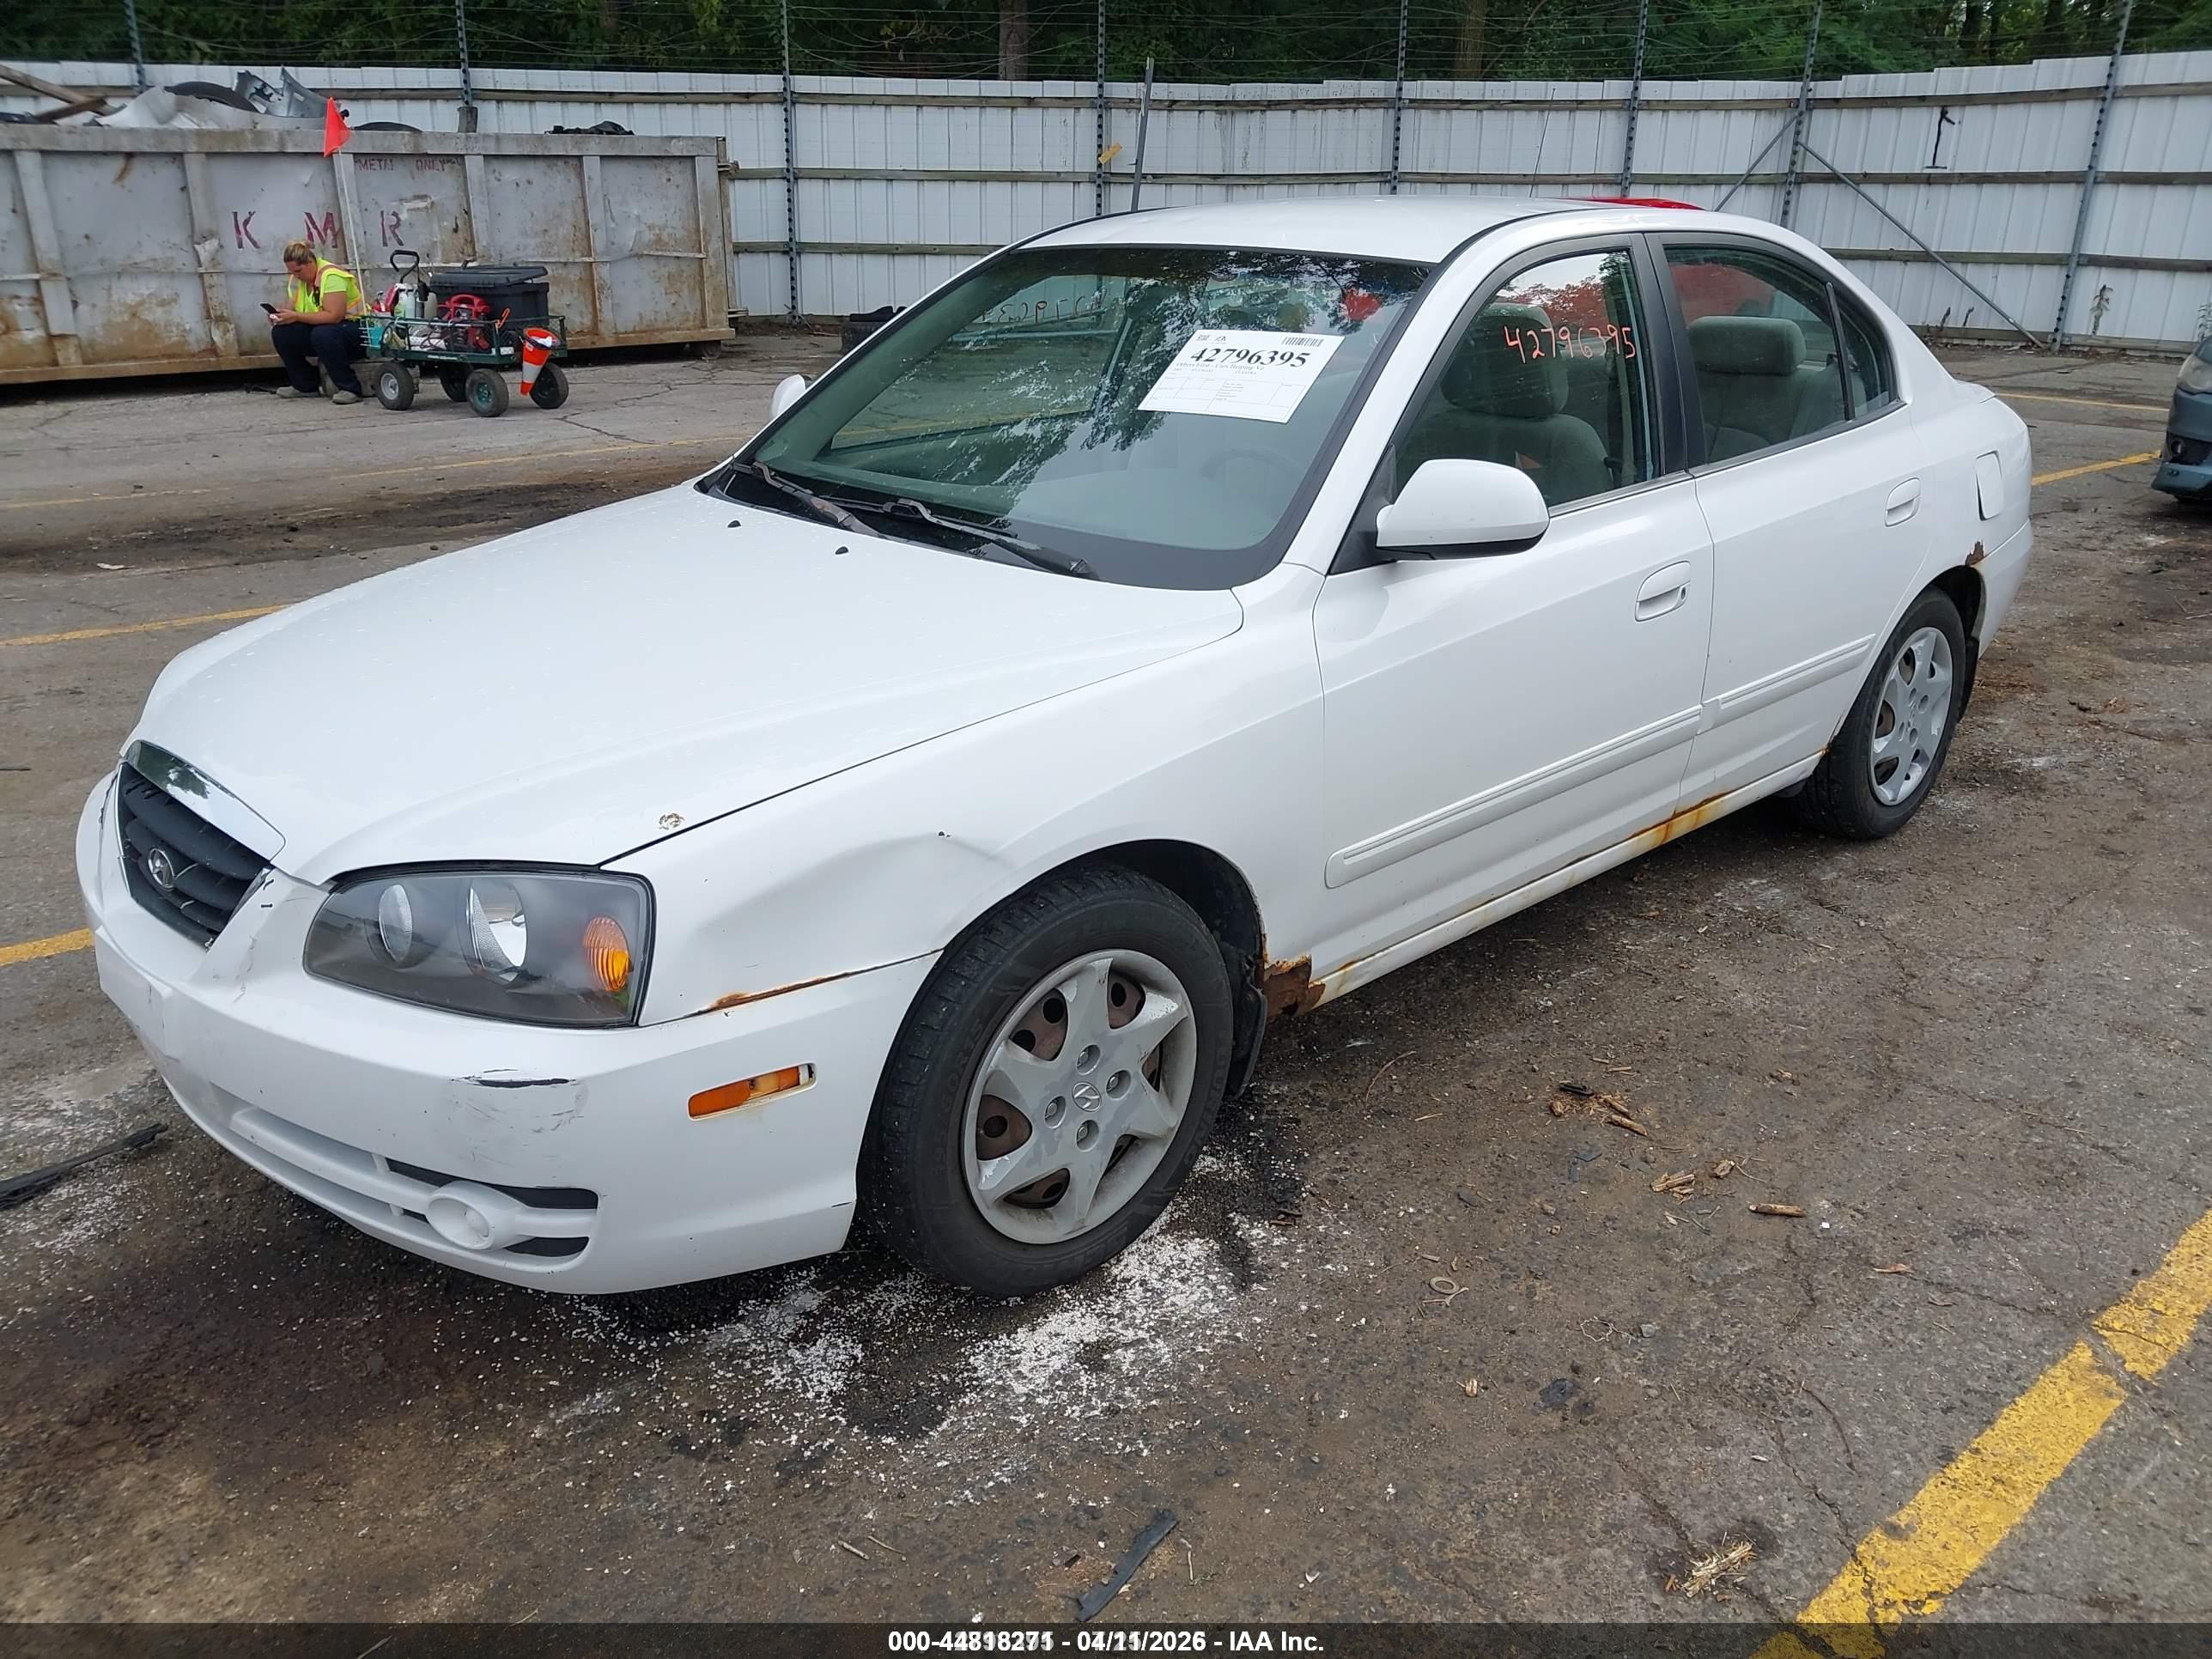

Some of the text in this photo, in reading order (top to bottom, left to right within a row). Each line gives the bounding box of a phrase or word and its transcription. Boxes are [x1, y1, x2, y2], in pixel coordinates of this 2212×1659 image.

[232, 210, 404, 249] K M R
[1190, 347, 1311, 368] 42796395
[1504, 323, 1636, 364] 42796395
